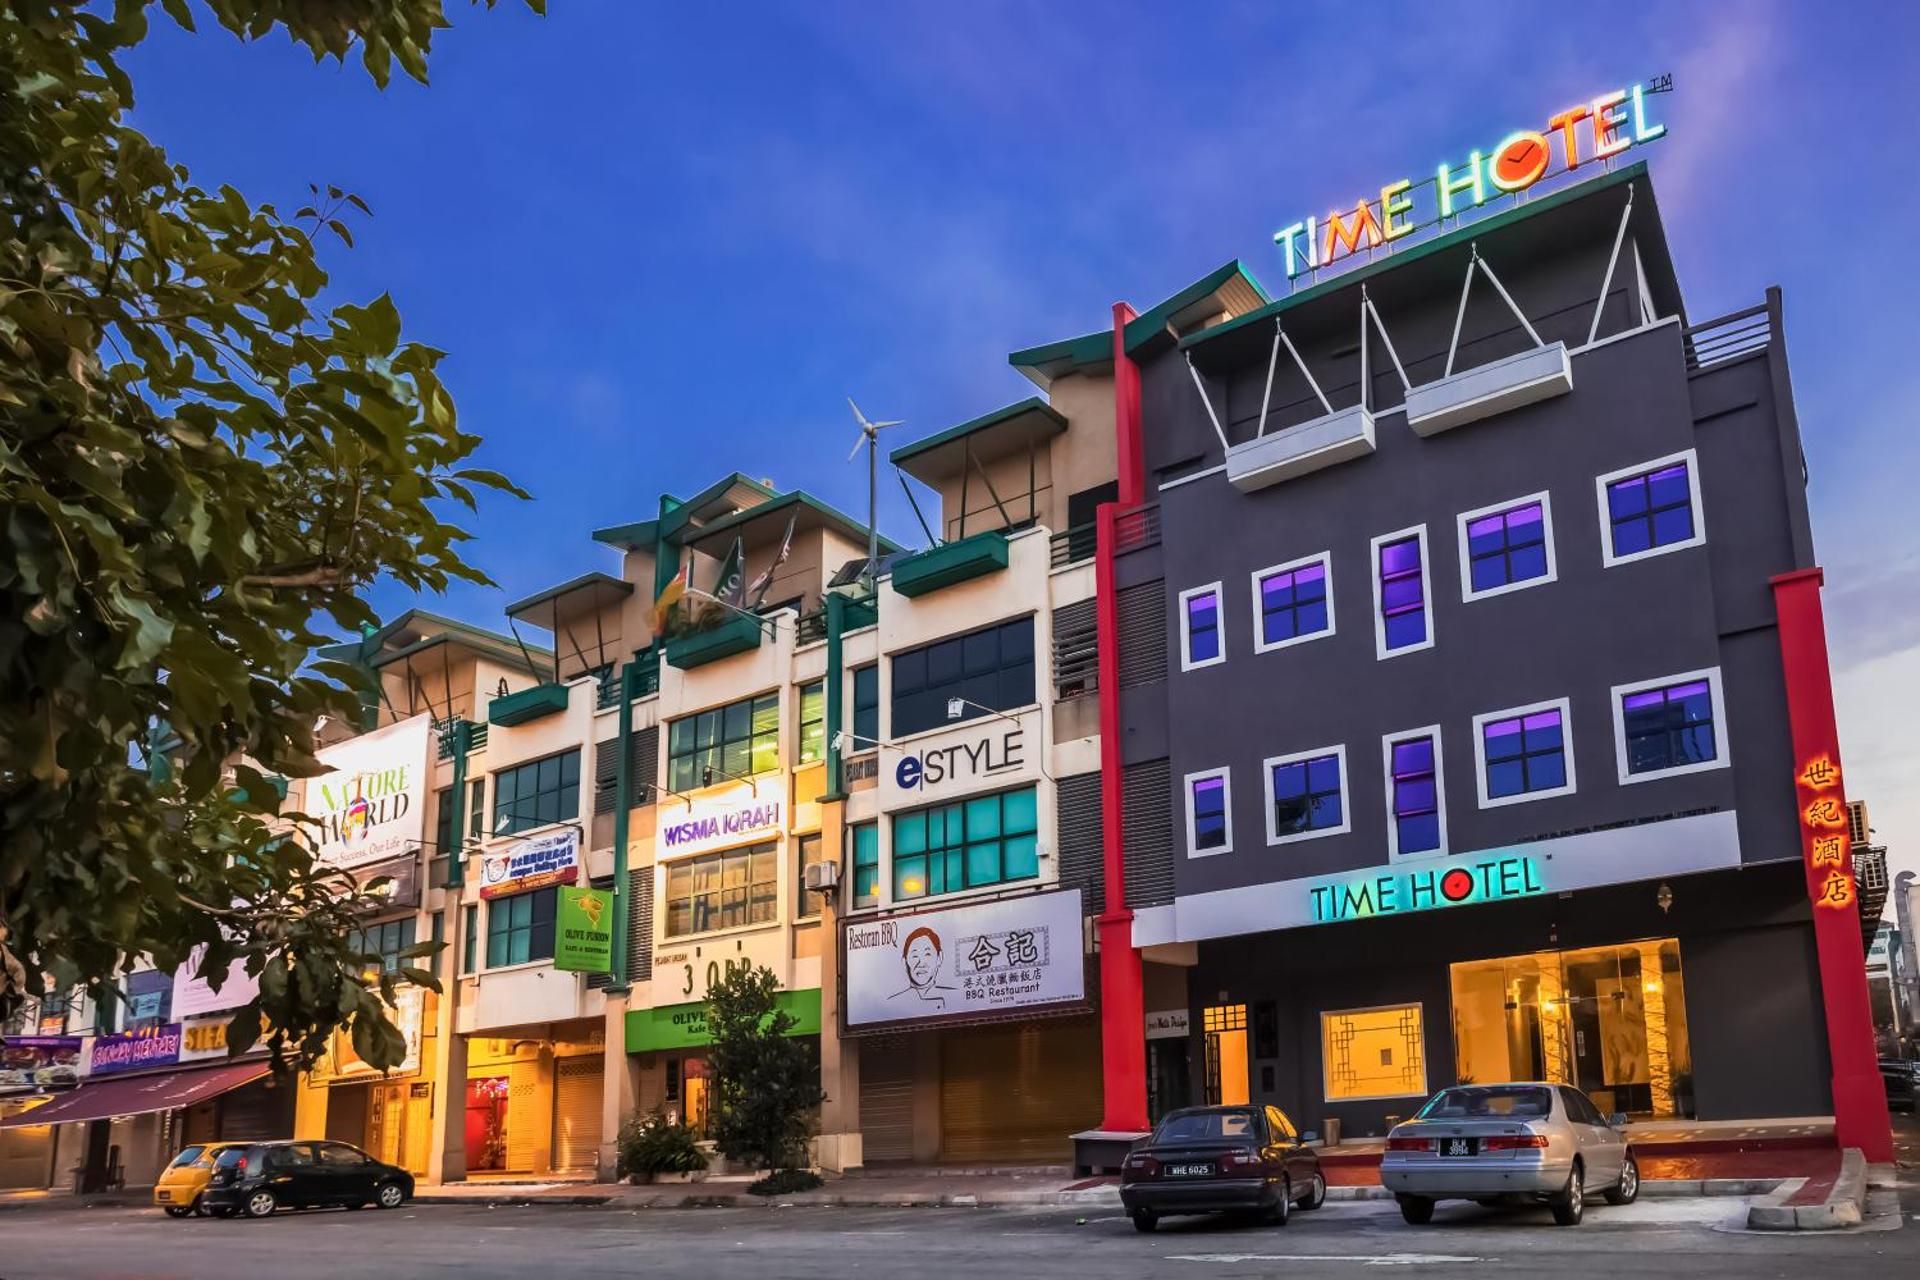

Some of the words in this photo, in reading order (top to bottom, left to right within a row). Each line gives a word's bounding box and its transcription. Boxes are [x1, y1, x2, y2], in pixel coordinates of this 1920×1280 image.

[1273, 179, 1414, 279] TIME
[1437, 84, 1668, 217] HOTEL
[664, 816, 720, 848] WISMA
[1804, 760, 1850, 903] 世紀酒店
[1311, 876, 1396, 921] TIME
[1411, 857, 1541, 909] HOTEL
[849, 927, 880, 951] Restoran
[881, 920, 898, 948] BBQ
[965, 988, 985, 1001] BBQ
[988, 982, 1041, 998] Restaurant
